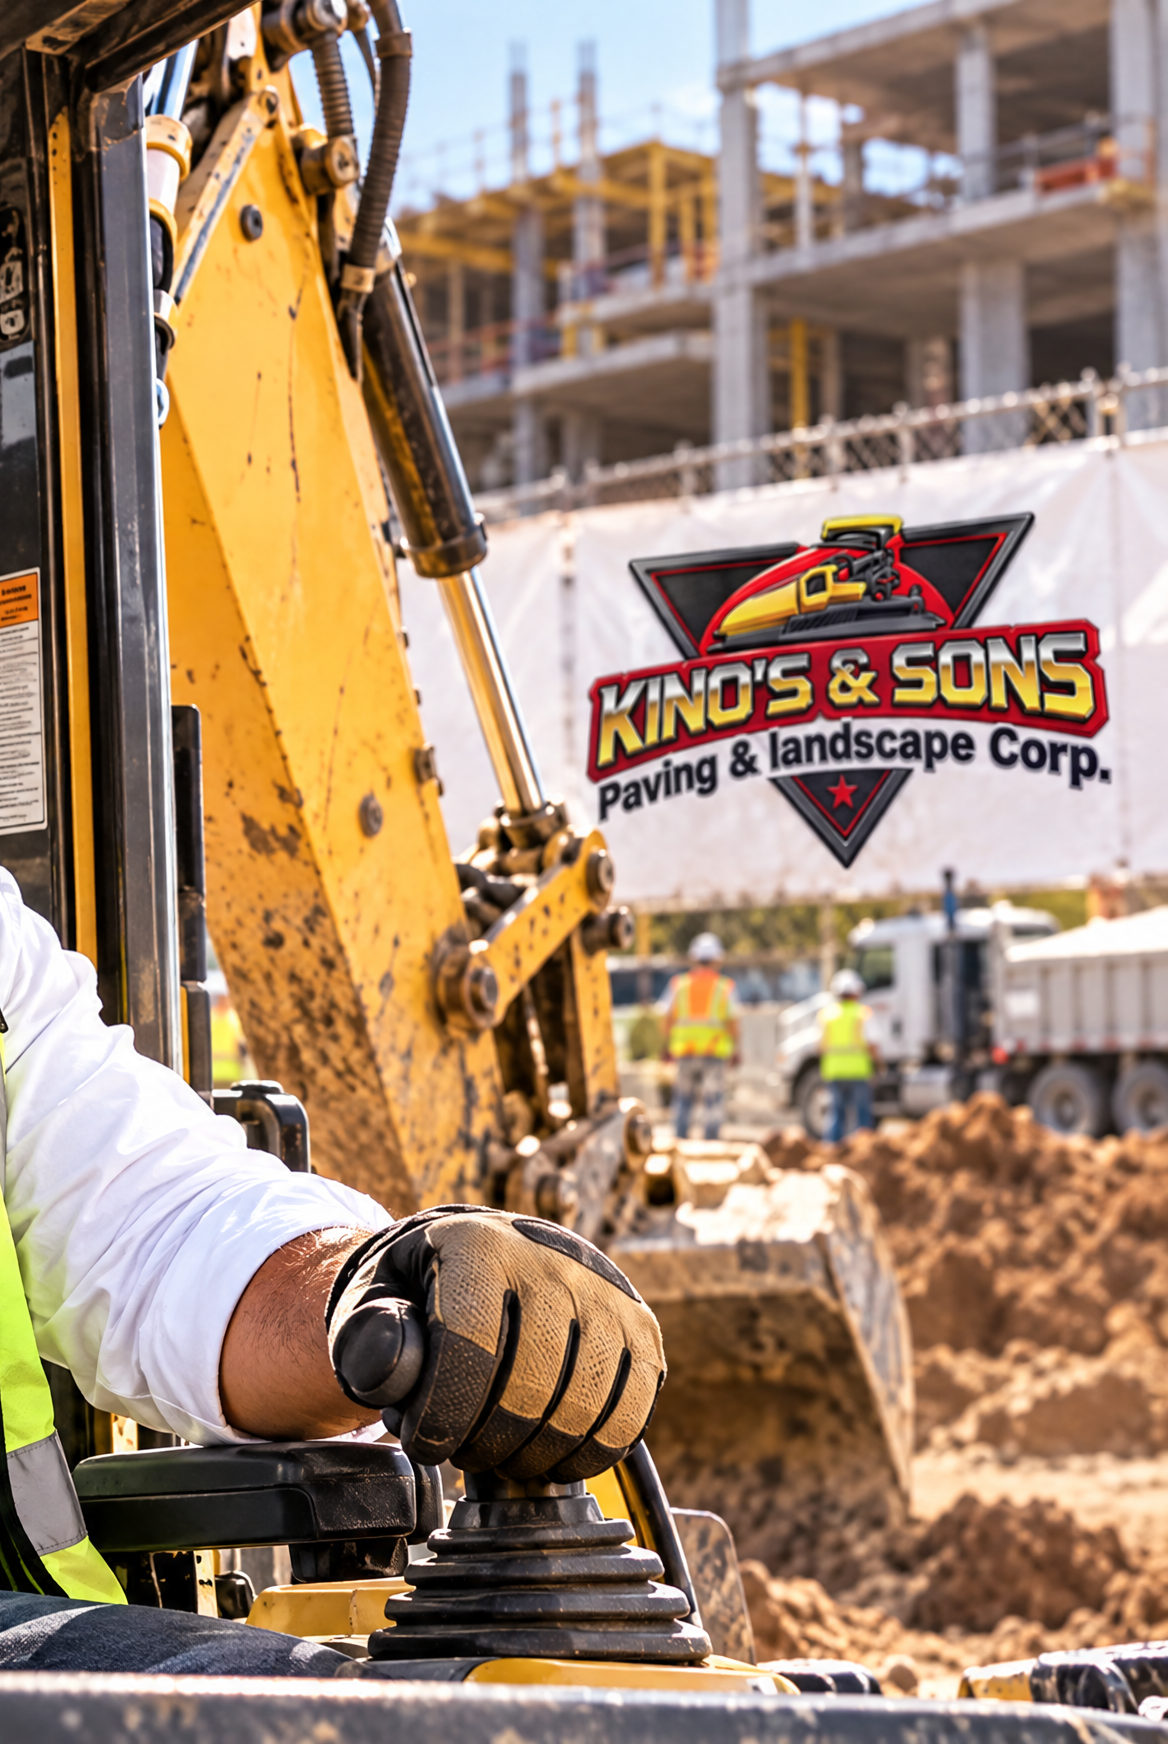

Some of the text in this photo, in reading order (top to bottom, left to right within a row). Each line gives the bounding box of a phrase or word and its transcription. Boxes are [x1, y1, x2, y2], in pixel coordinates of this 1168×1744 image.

[596, 631, 1096, 768] KINO'S & SONS
[598, 719, 1111, 821] Paving & landscape Corp.
